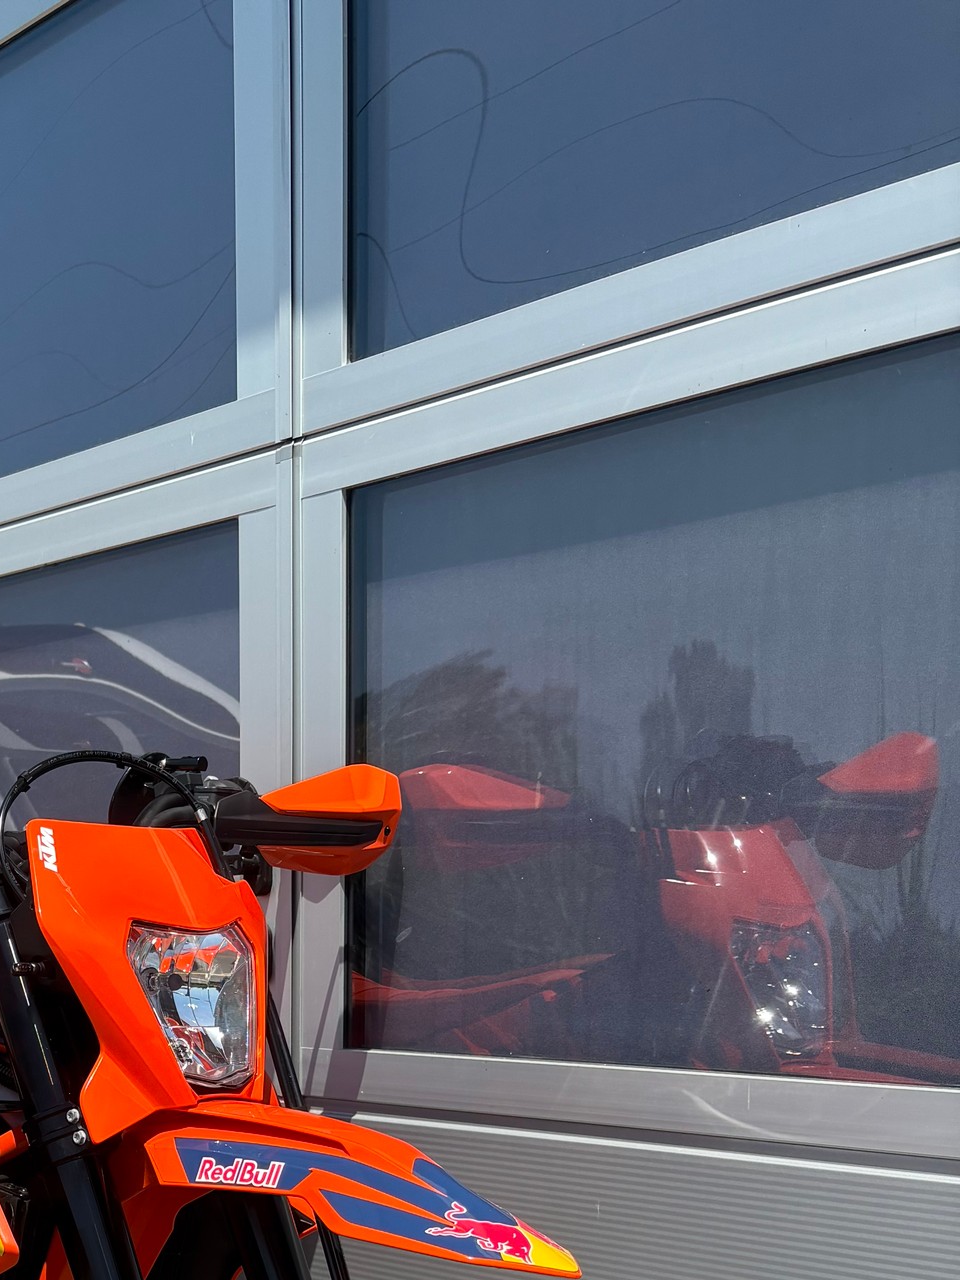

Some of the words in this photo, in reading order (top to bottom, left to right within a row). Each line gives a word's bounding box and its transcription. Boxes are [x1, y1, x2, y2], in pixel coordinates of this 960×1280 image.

[38, 827, 58, 873] KTM
[196, 1157, 242, 1183] Red
[237, 1159, 285, 1188] Bull
